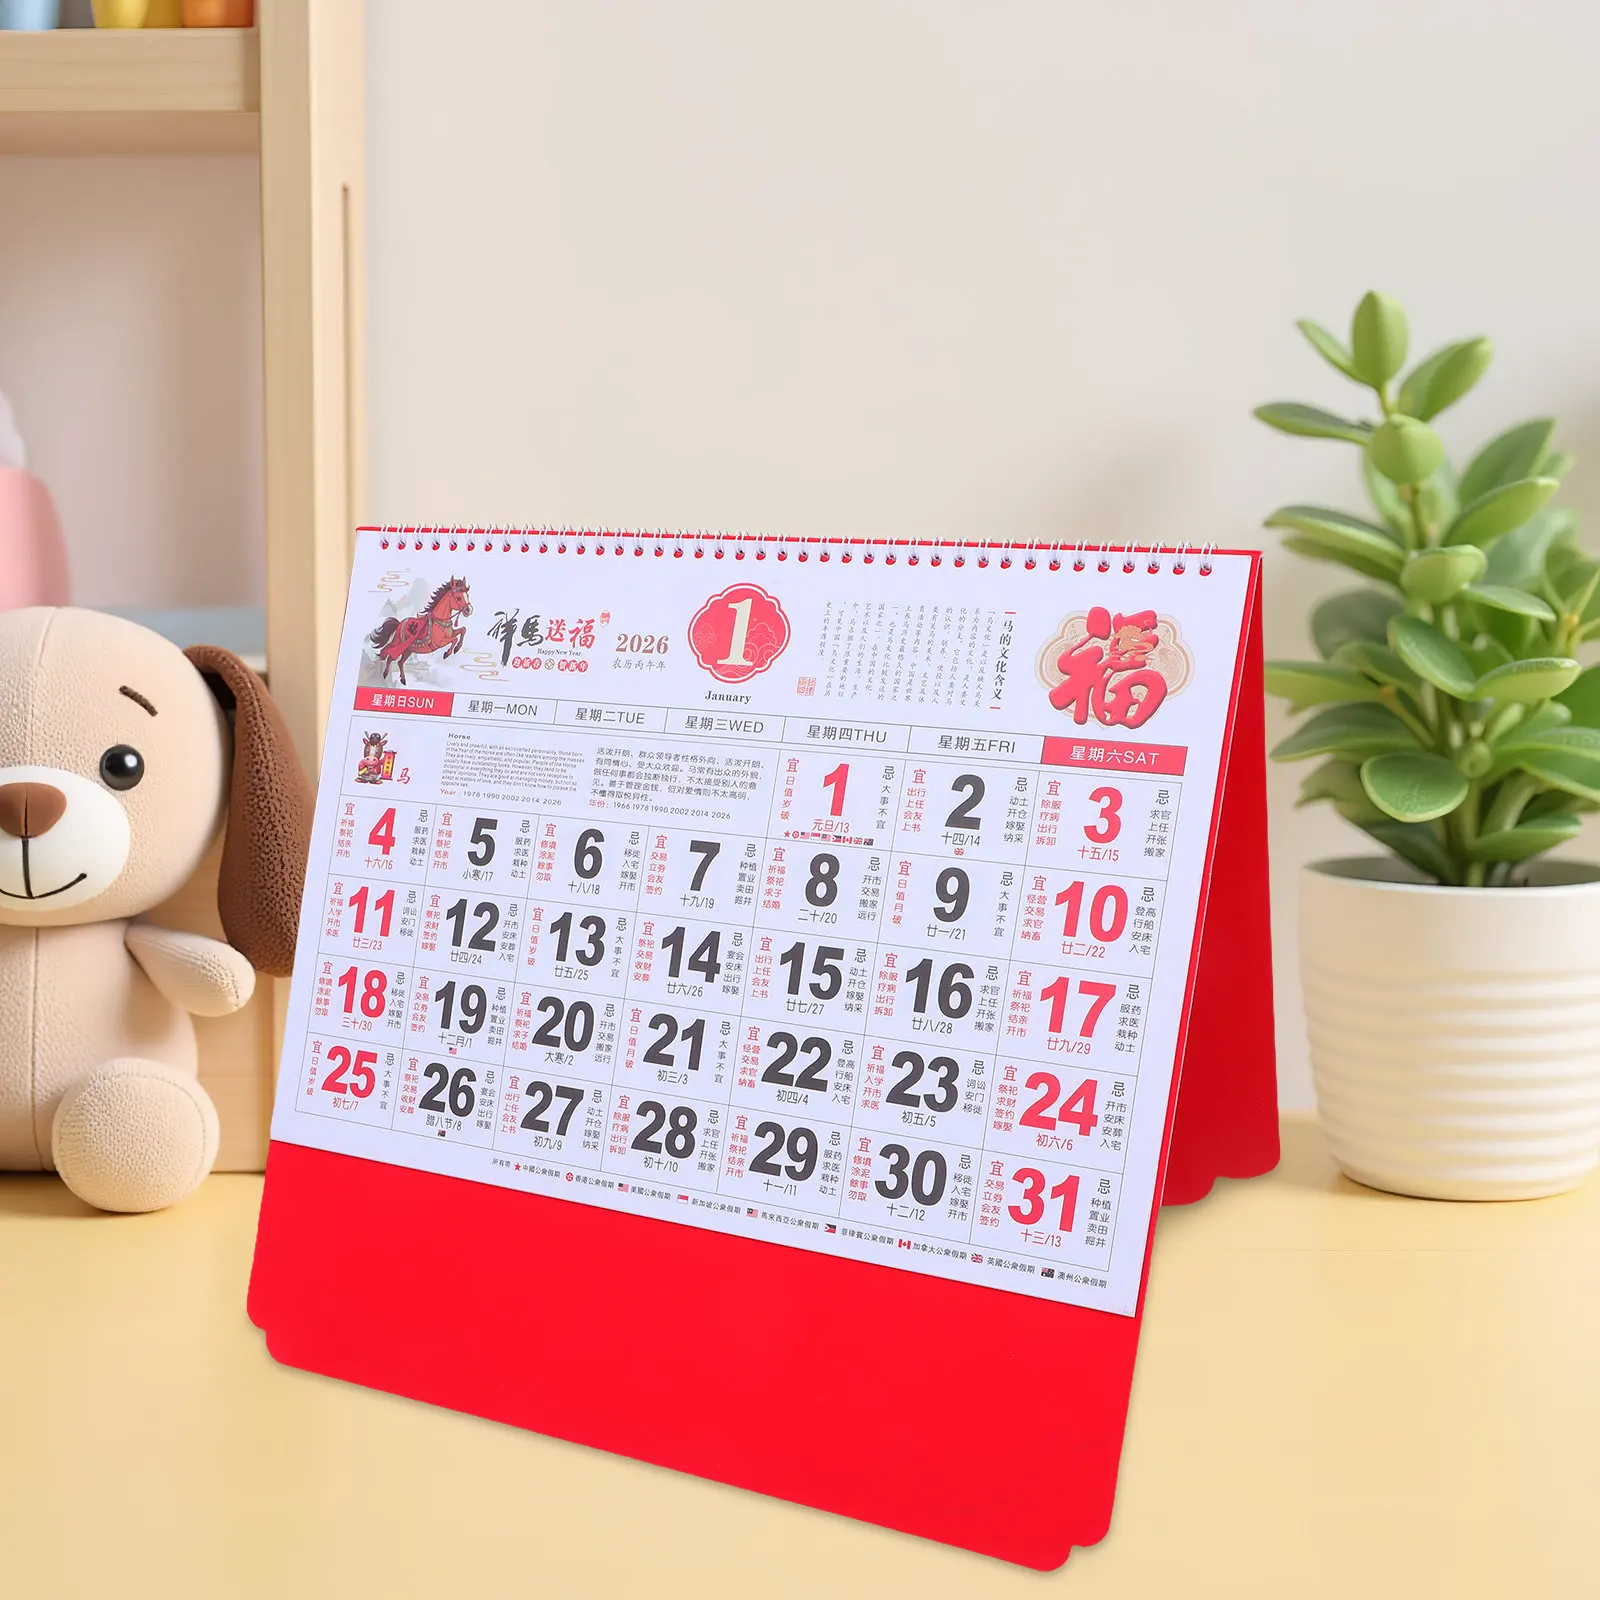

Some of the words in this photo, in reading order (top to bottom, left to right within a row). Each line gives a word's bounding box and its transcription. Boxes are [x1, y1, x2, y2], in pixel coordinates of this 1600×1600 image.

[716, 598, 753, 666] 1
[537, 648, 554, 656] Happy
[615, 633, 669, 654] 2026
[512, 656, 542, 669] 迎新春
[611, 657, 666, 671] 农历丙午年
[991, 620, 1013, 700] 马的文化含义
[1049, 606, 1168, 730] 福
[371, 693, 434, 708] 星期日SUN
[704, 690, 751, 704] January
[467, 699, 538, 716] 星期一MON
[574, 707, 645, 724] 星期二TUE
[684, 715, 763, 733] 星期三WED
[448, 732, 470, 740] Horse
[806, 724, 887, 743] 星期四THU
[937, 734, 1015, 753] 星期五FRI
[1069, 745, 1159, 765] 星期六SAT
[397, 768, 411, 784] 马
[911, 768, 926, 784] 宜
[822, 763, 850, 817] 1
[906, 787, 926, 797] 出行
[1155, 789, 1169, 805] 忌
[501, 793, 519, 801] 2002
[521, 795, 539, 803] 2014
[542, 798, 561, 806] 2026
[904, 798, 924, 809] 上任
[944, 773, 985, 830] 2
[613, 801, 630, 809] 1966
[632, 803, 649, 811] 1978
[650, 805, 668, 813] 1990
[669, 807, 689, 815] 2002
[690, 808, 708, 817] 2014
[711, 811, 730, 819] 2026
[903, 810, 923, 821] 会友
[1083, 786, 1123, 844] 3
[1149, 809, 1171, 820] 求官
[367, 807, 396, 856] 4
[811, 818, 849, 833] 元旦/13
[900, 821, 921, 832] 上书
[1147, 821, 1169, 833] 上任
[467, 816, 498, 867] 5
[940, 831, 980, 847] 十四/14
[1145, 833, 1167, 845] 开张
[573, 828, 605, 879] 6
[1076, 844, 1119, 861] 十五/15
[1143, 846, 1165, 858] 搬家
[364, 856, 393, 870] 十六/16
[689, 839, 721, 892] 7
[461, 868, 493, 882] 小寒/17
[804, 852, 840, 907] 8
[567, 880, 600, 895] 十八/18
[932, 866, 970, 923] 9
[679, 893, 714, 909] 十九/19
[347, 885, 395, 937] 11
[797, 908, 837, 924] 二十/20
[1054, 880, 1128, 942] 10
[445, 898, 499, 952] 12
[641, 920, 655, 936] 宜
[926, 923, 965, 940] 廿一/21
[352, 936, 382, 950] 廿三/23
[549, 911, 606, 966] 13
[637, 938, 655, 949] 祭祀
[450, 949, 482, 965] 廿四/24
[635, 949, 653, 960] 交易
[660, 925, 721, 983] 14
[1061, 940, 1105, 958] 廿二/22
[554, 963, 589, 980] 廿五/25
[632, 971, 650, 982] 安葬
[779, 941, 845, 1000] 15
[337, 965, 388, 1018] 18
[666, 980, 703, 997] 廿六/26
[905, 957, 975, 1019] 16
[1125, 983, 1140, 1000] 忌
[434, 980, 487, 1034] 19
[785, 998, 824, 1015] 廿七/27
[1039, 975, 1117, 1038] 17
[1119, 1003, 1142, 1015] 服药
[341, 1016, 372, 1031] 三十/30
[531, 995, 594, 1052] 20
[911, 1016, 952, 1034] 廿八/28
[1117, 1016, 1140, 1028] 求医
[437, 1031, 472, 1048] 十二月/1
[642, 1012, 705, 1071] 21
[1046, 1036, 1091, 1055] 廿九/29
[1114, 1041, 1135, 1053] 动土
[543, 1050, 574, 1066] 大寒/2
[760, 1031, 832, 1093] 22
[320, 1045, 378, 1099] 25
[656, 1068, 688, 1085] 初三/3
[417, 1062, 477, 1117] 26
[884, 1050, 959, 1113] 23
[331, 1096, 359, 1111] 初七/7
[775, 1088, 808, 1105] 初四/4
[1018, 1071, 1099, 1137] 24
[519, 1080, 585, 1136] 27
[901, 1109, 936, 1127] 初五/5
[630, 1100, 697, 1159] 28
[533, 1134, 562, 1151] 初九/9
[1035, 1132, 1073, 1151] 初六/6
[748, 1120, 818, 1182] 29
[642, 1155, 678, 1173] 初十/10
[988, 1159, 1004, 1177] 宜
[874, 1143, 947, 1206] 30
[762, 1178, 797, 1196] 十一/11
[983, 1178, 1004, 1191] 交易
[1007, 1167, 1080, 1233] 31
[886, 1202, 925, 1221] 十二/12
[980, 1203, 1001, 1215] 会友
[979, 1214, 1000, 1228] 签约
[1020, 1228, 1061, 1248] 十三/13
